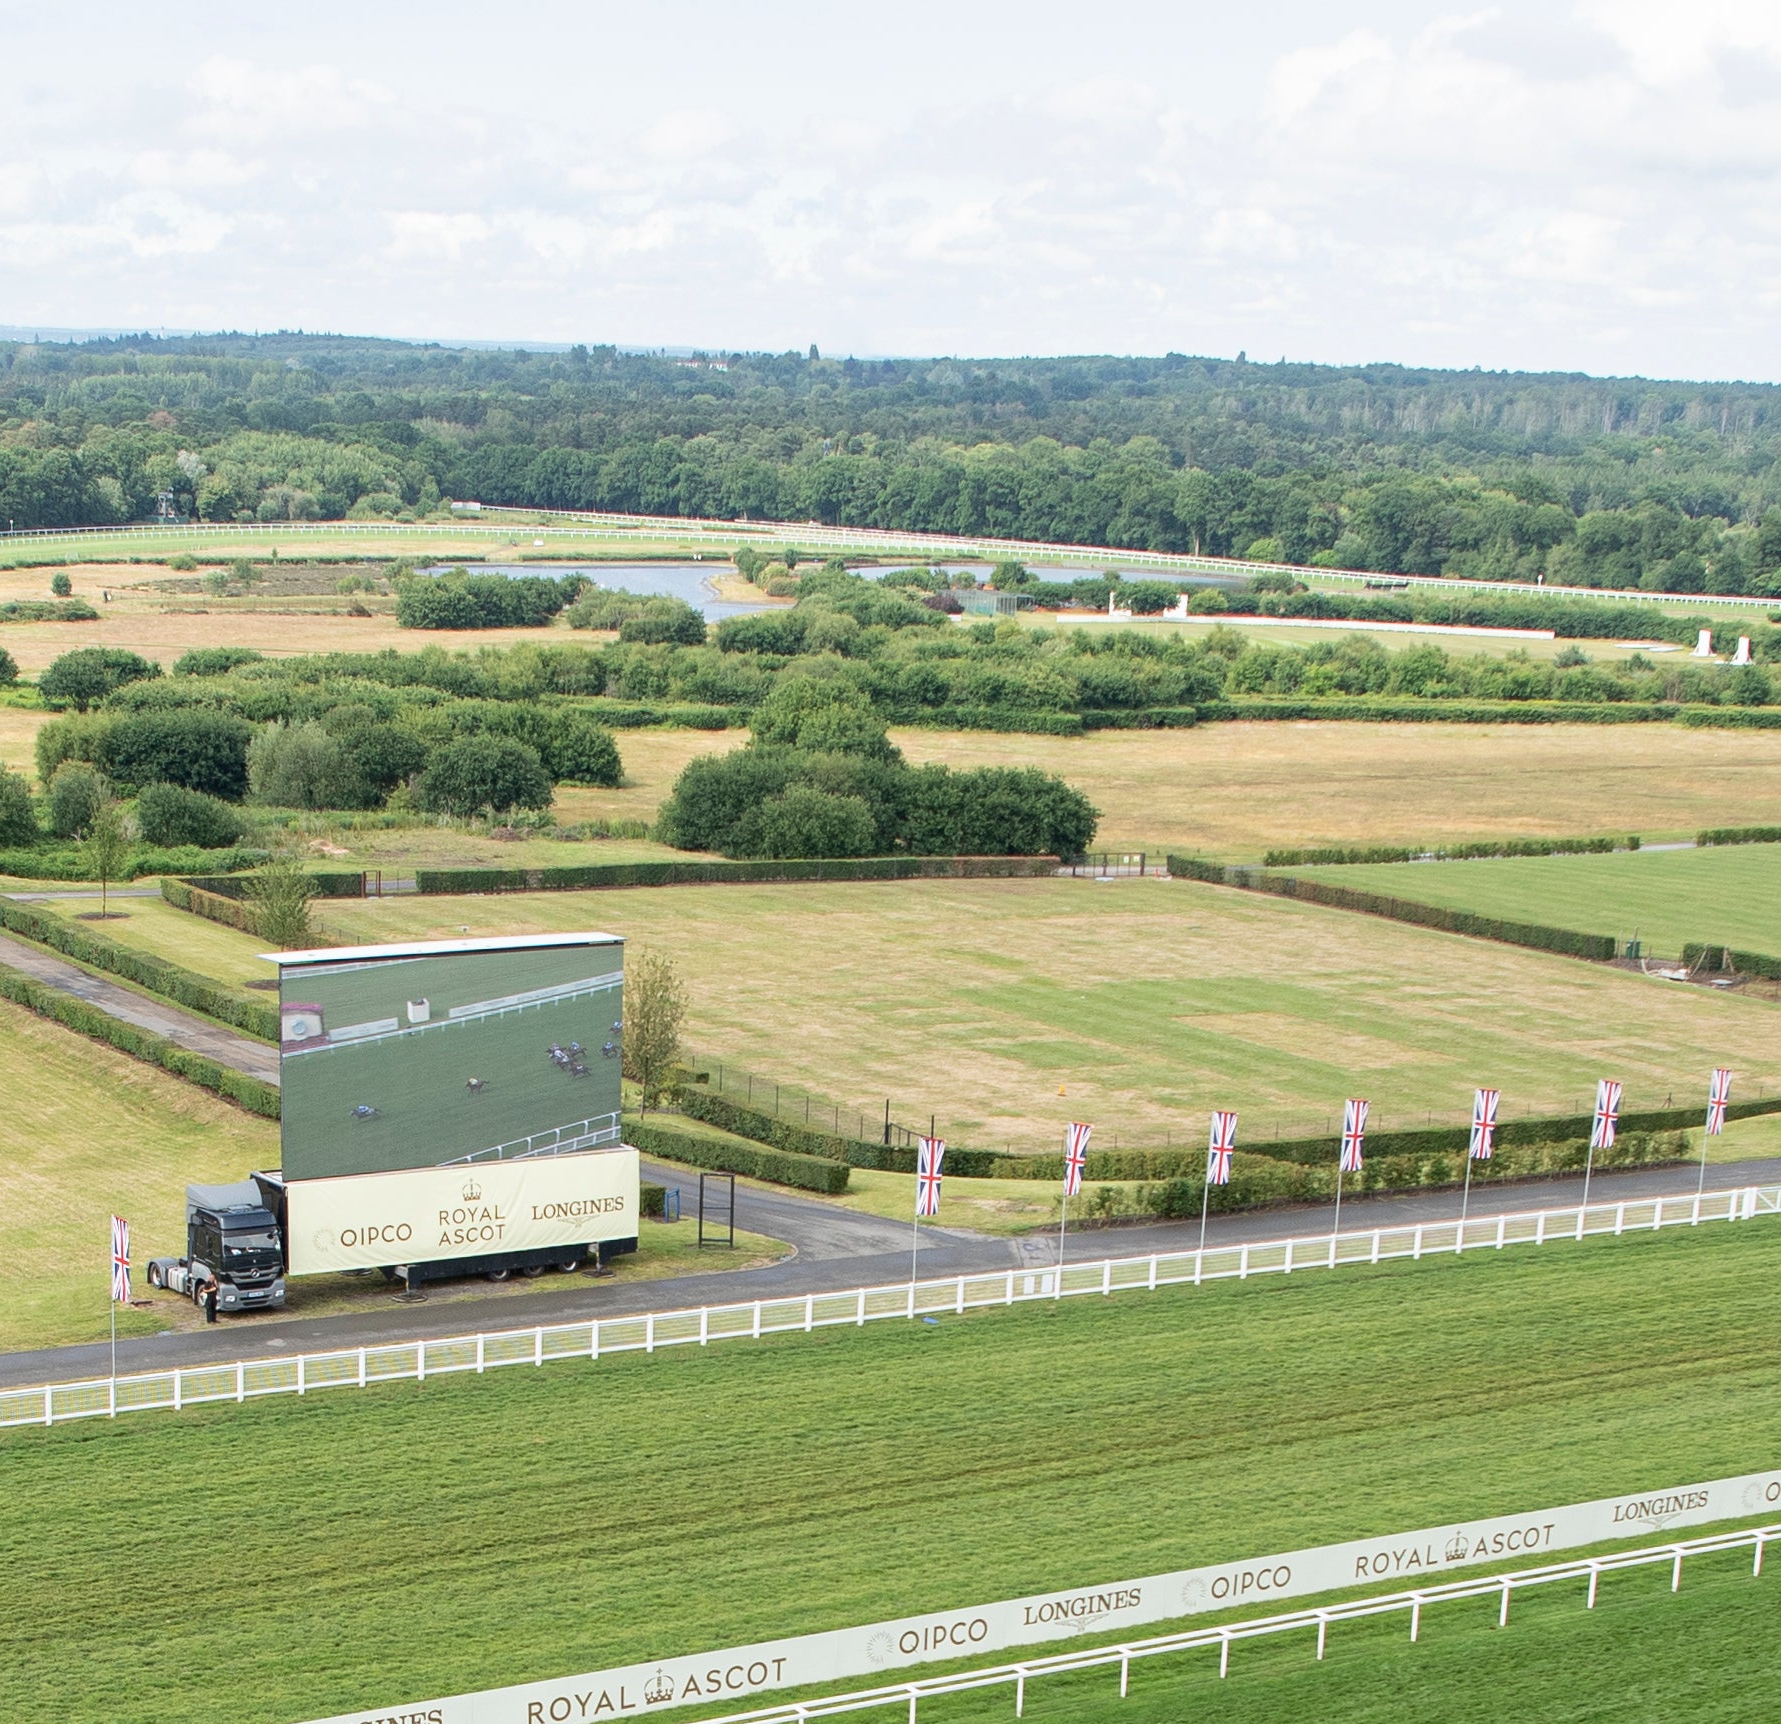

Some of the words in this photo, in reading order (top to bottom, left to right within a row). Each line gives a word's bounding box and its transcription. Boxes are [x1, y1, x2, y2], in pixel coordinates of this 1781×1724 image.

[438, 1204, 506, 1226] ROYAL
[531, 1196, 625, 1221] LONGINES
[340, 1223, 413, 1248] QIPCO
[438, 1223, 505, 1247] ASCOT
[1613, 1490, 1709, 1525] LONGINES
[1355, 1545, 1439, 1577] ROYAL
[1474, 1523, 1555, 1558] ASCOT
[1211, 1565, 1292, 1600] QIPCO
[1022, 1587, 1142, 1627] LONGINES
[899, 1618, 988, 1655] QIPCO
[681, 1657, 788, 1701] ASCOT
